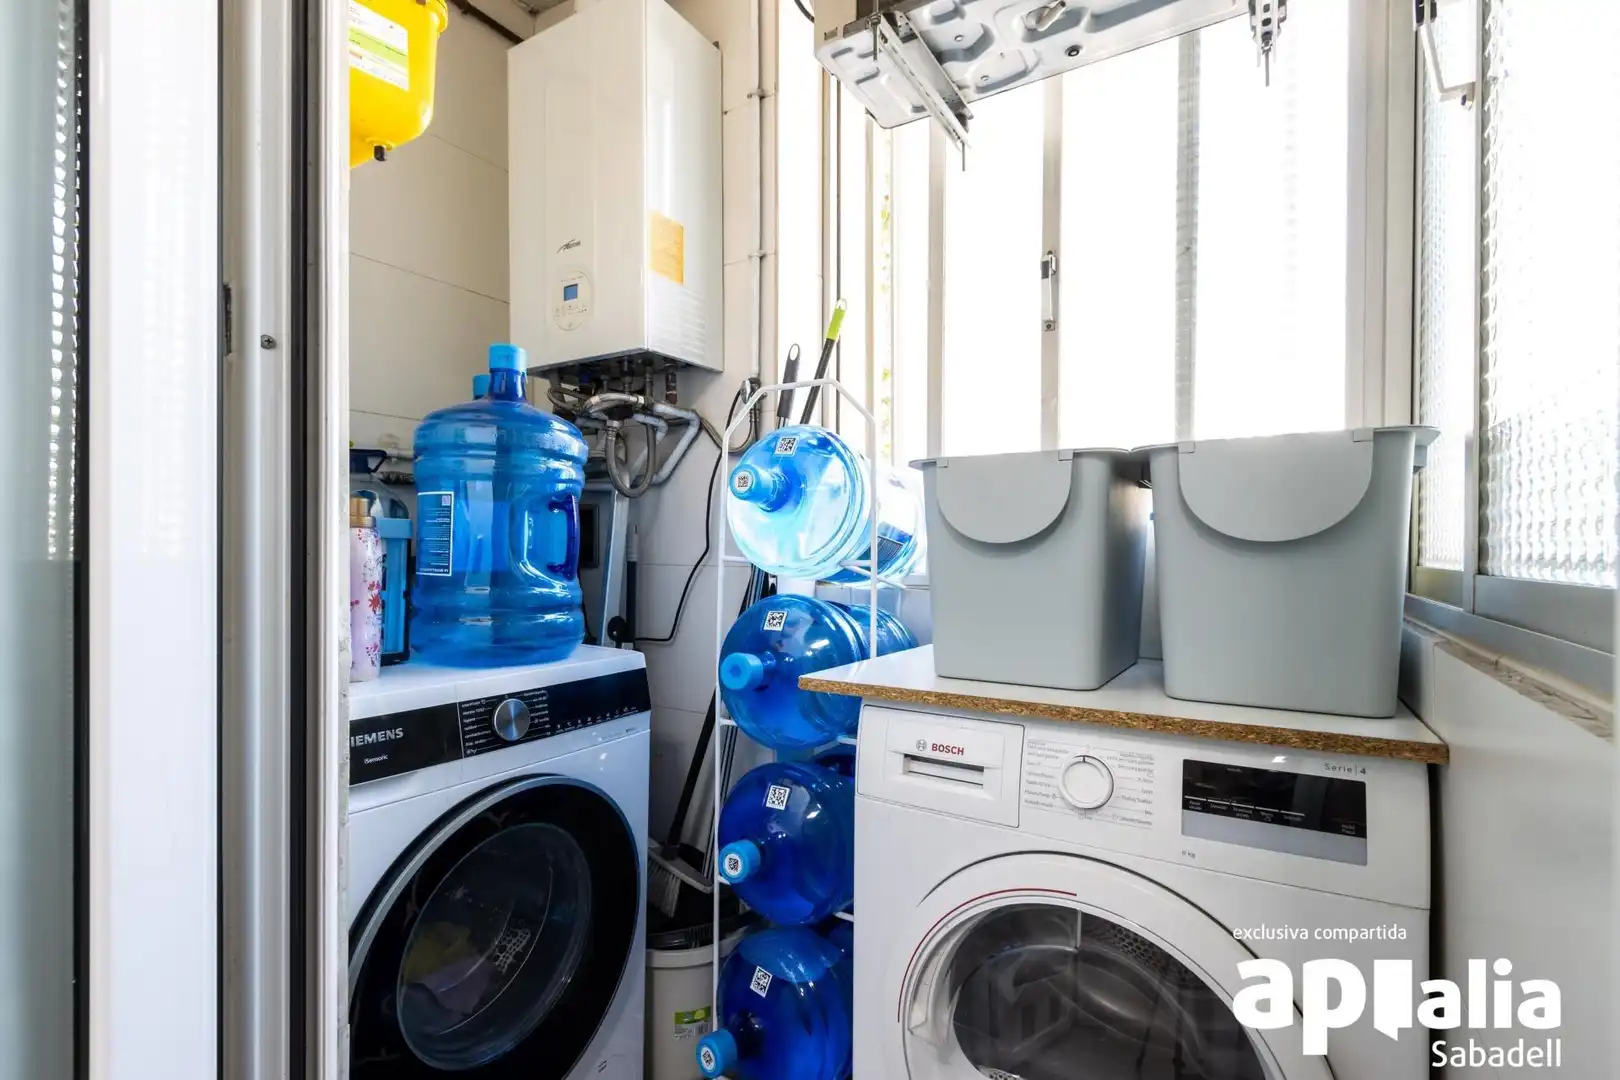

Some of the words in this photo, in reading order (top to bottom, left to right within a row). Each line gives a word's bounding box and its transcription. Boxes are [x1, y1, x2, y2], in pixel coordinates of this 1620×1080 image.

[350, 727, 404, 748] IEMENS
[931, 743, 965, 756] BOSCH
[1324, 762, 1353, 774] Serie
